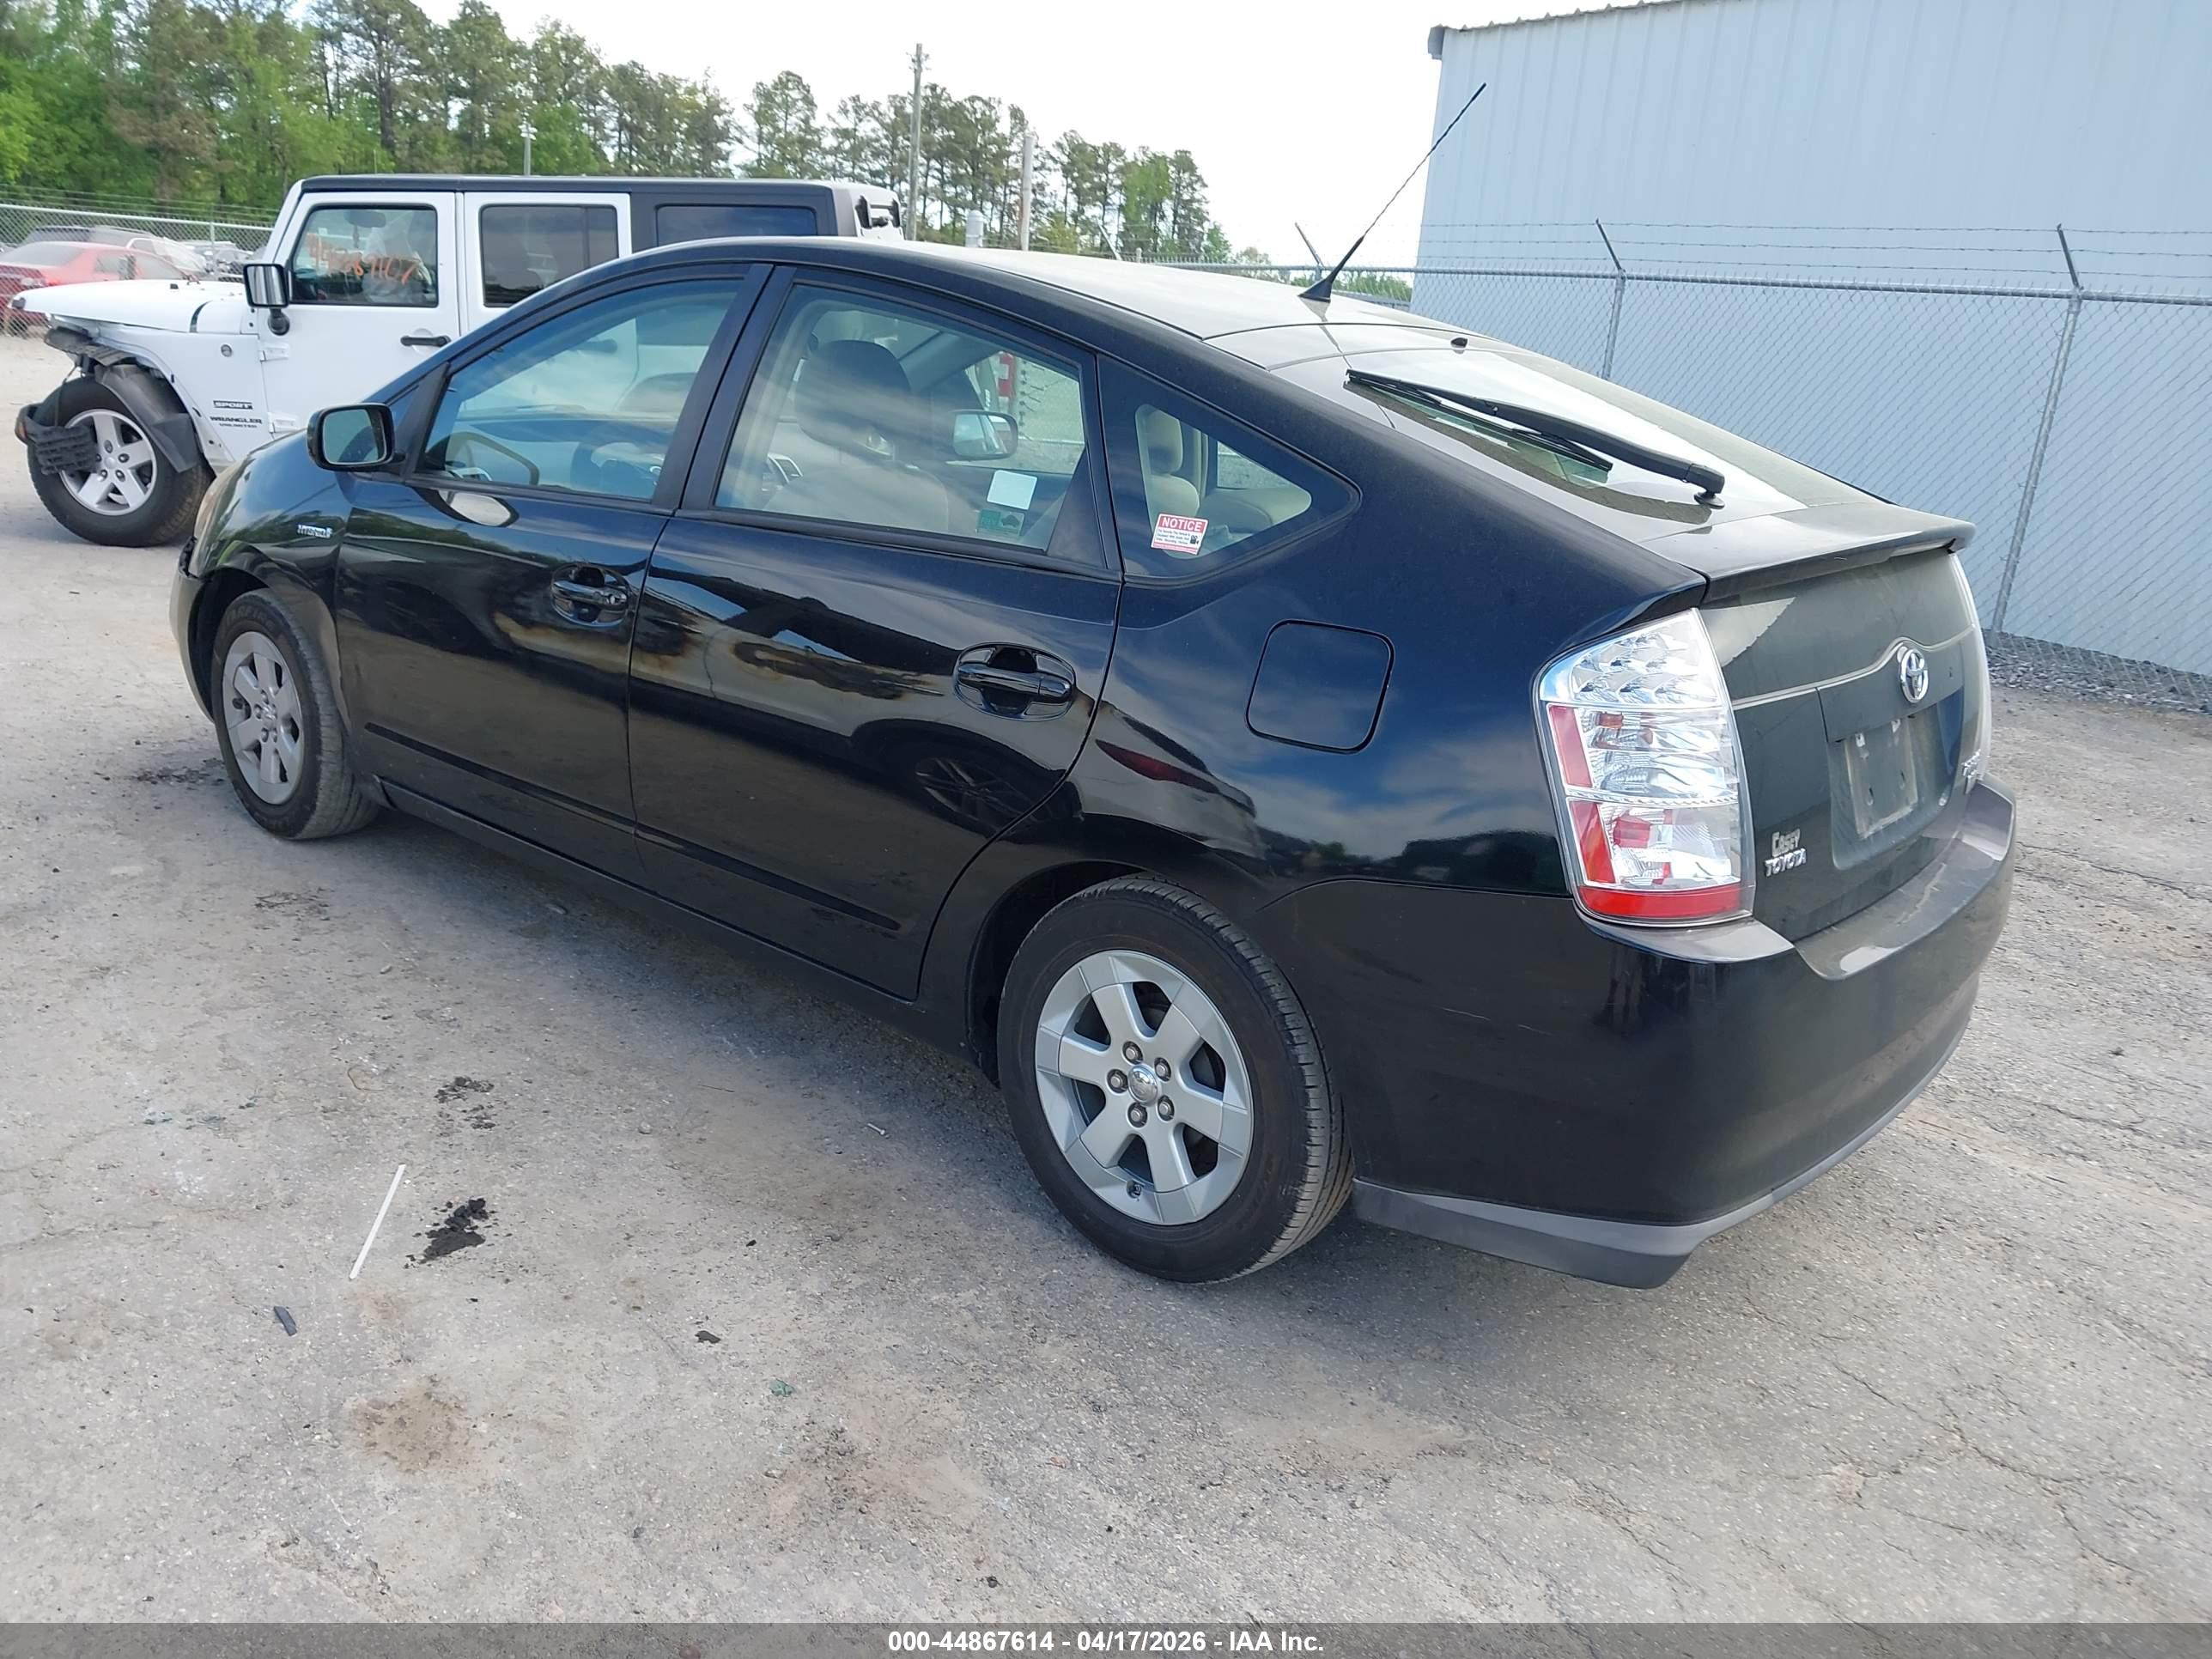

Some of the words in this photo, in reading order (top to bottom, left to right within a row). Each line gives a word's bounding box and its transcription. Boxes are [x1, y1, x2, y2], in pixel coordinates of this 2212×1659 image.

[210, 416, 263, 425] WRANGLER
[1161, 516, 1203, 532] NOTICE
[1765, 847, 1807, 877] TOYOTA
